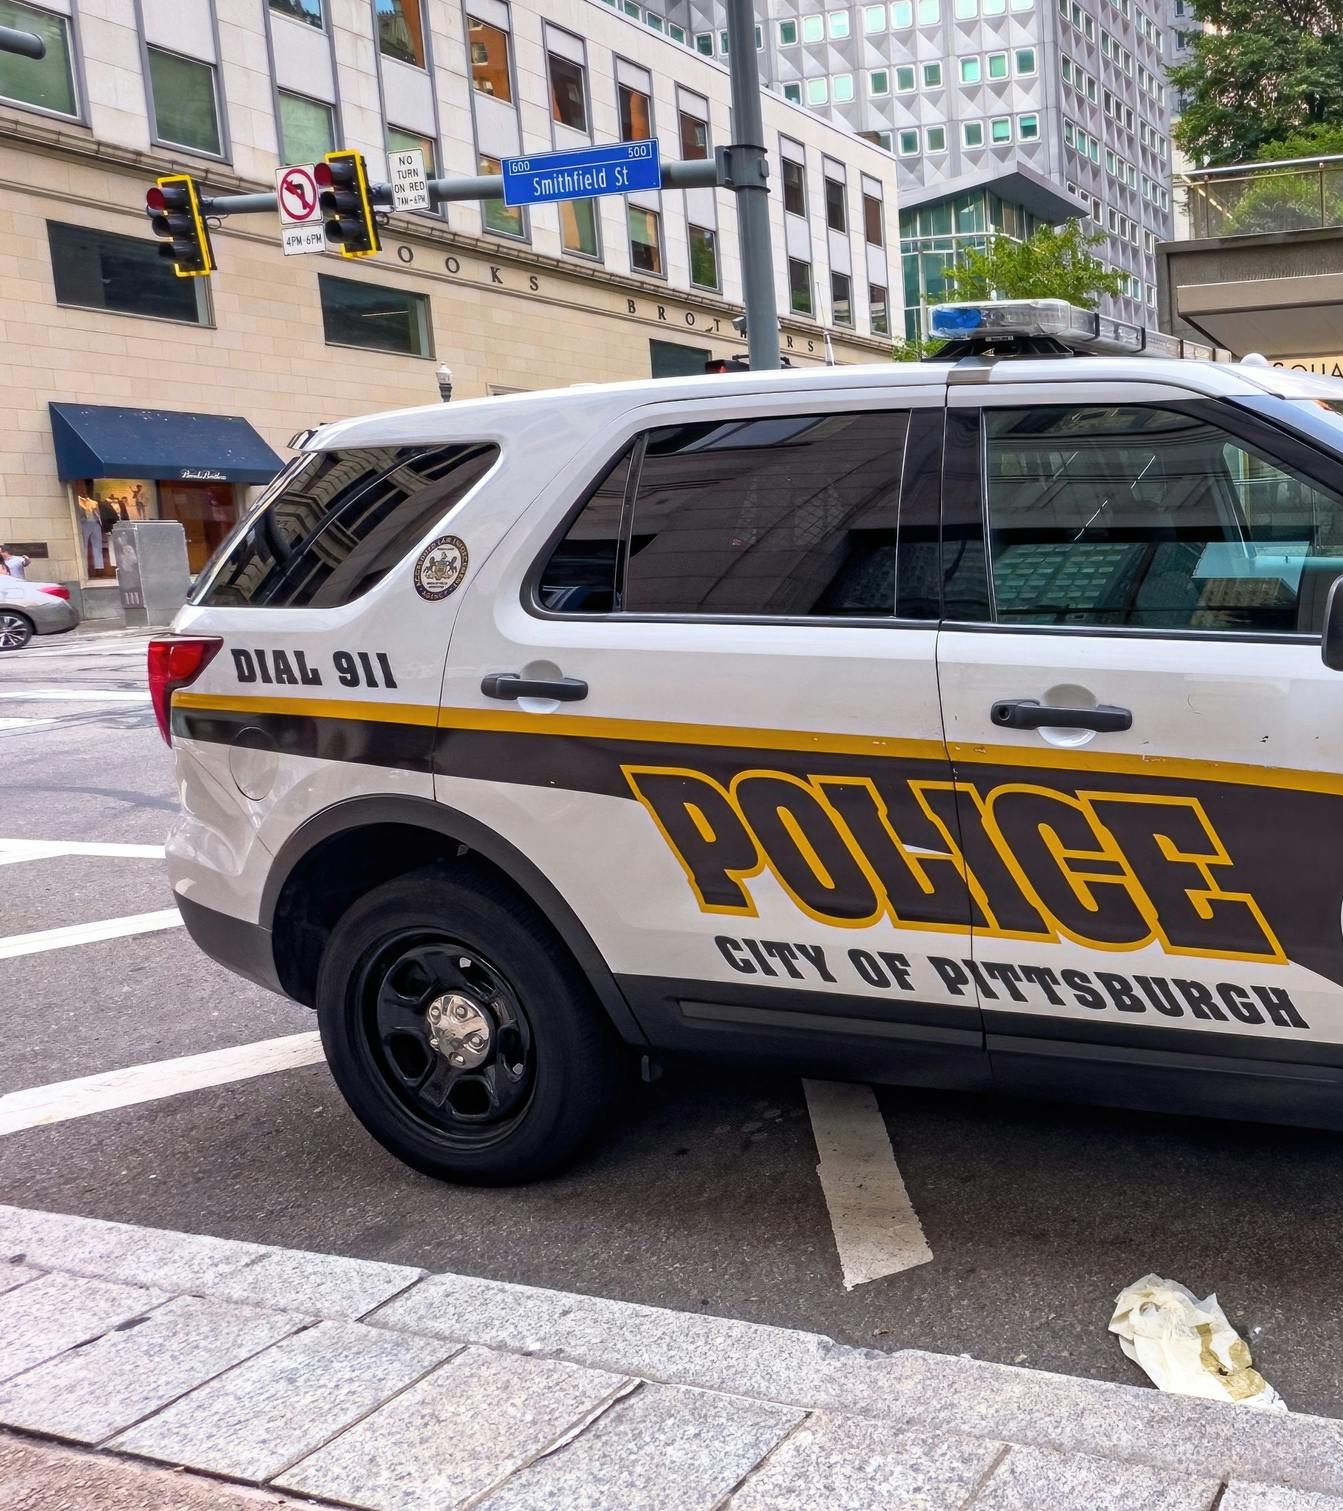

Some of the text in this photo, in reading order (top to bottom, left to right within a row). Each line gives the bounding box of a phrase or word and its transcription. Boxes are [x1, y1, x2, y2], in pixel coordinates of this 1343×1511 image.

[396, 168, 419, 179] TURN
[399, 155, 413, 166] NO
[512, 145, 647, 173] 600 500
[394, 181, 425, 194] ON RED
[533, 165, 629, 196] Smithfield St
[627, 299, 814, 352] BROTRS
[230, 649, 398, 689] DIAL 911
[620, 764, 1290, 964] POLICE
[713, 934, 1311, 1030] CITY OF PITTSBURGH
